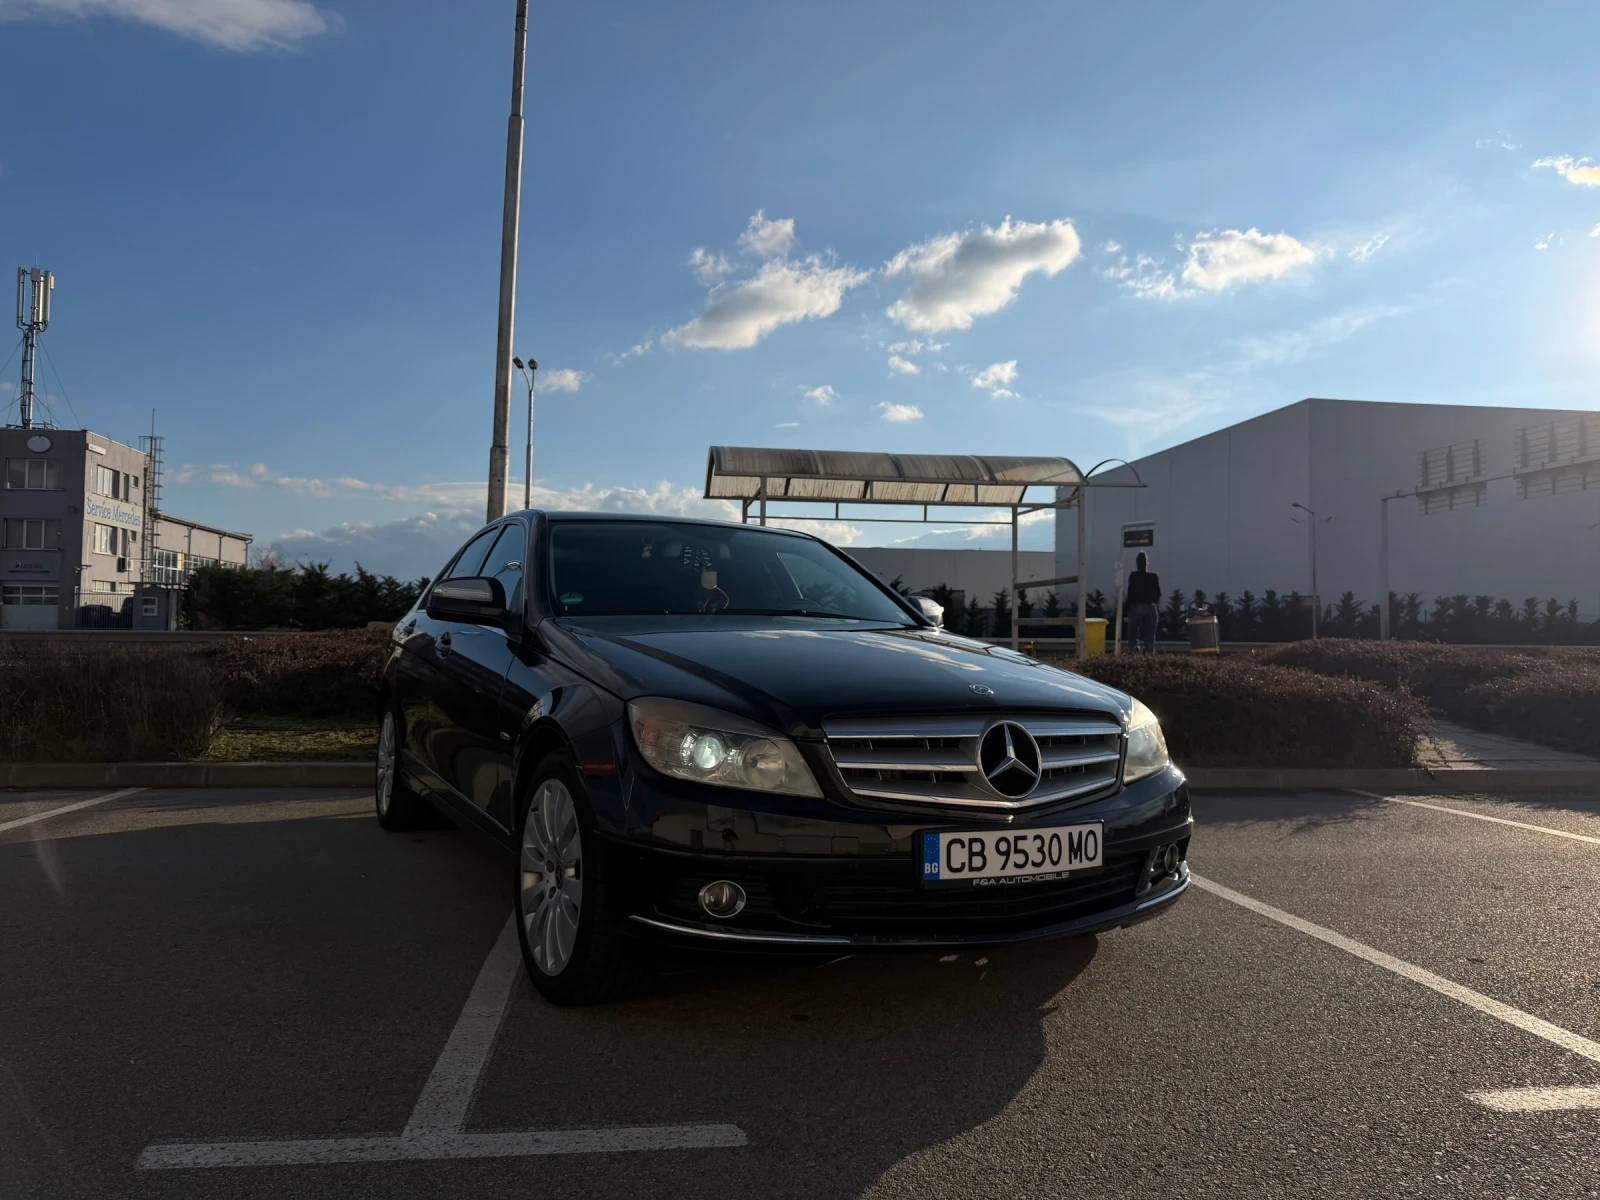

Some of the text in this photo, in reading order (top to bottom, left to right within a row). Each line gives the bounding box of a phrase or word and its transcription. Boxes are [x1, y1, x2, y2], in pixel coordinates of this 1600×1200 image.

[87, 498, 141, 527] Service Mercedes
[684, 546, 693, 565] VIP
[946, 830, 1098, 874] CB 9530 MO
[924, 862, 939, 874] BG
[972, 871, 1070, 886] F&A AUTOMOBILE
